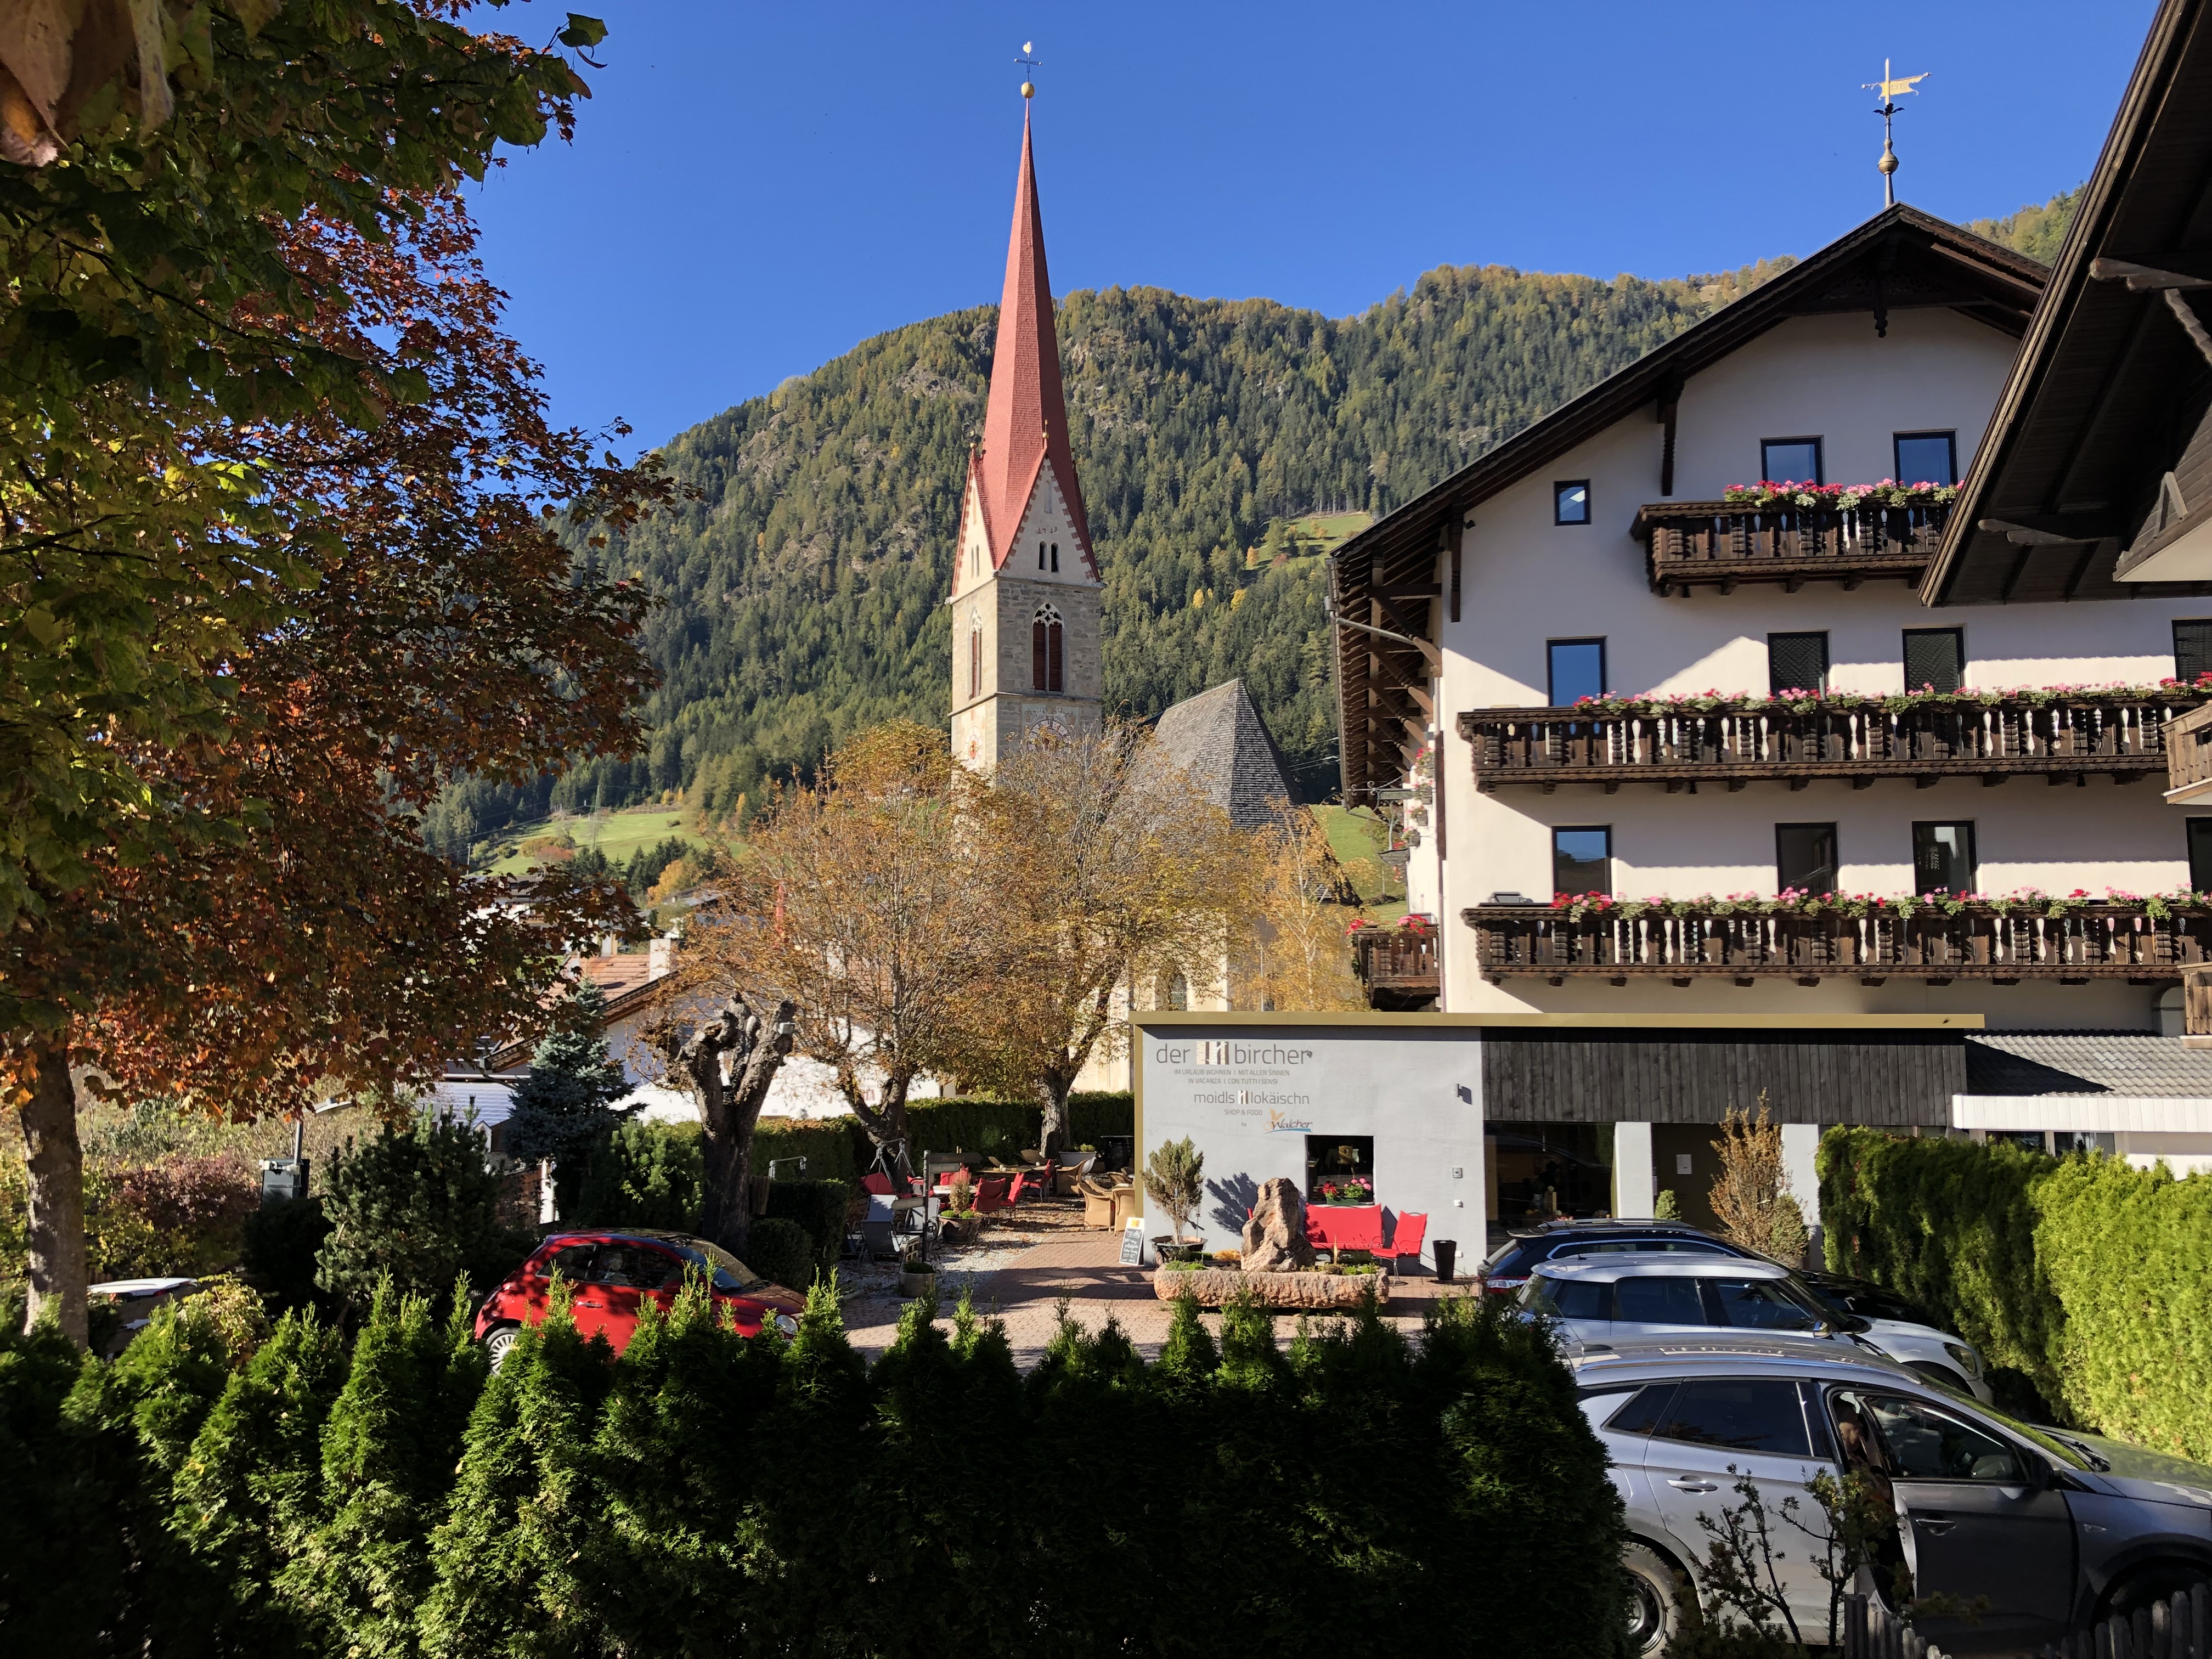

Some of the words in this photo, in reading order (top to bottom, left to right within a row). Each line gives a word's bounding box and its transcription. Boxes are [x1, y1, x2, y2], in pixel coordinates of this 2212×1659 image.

[1156, 1043, 1190, 1063] der
[1235, 1043, 1310, 1064] bircher
[1194, 1091, 1235, 1104] moidls
[1250, 1091, 1310, 1105] lokäischn
[1271, 1119, 1313, 1130] Walcher
